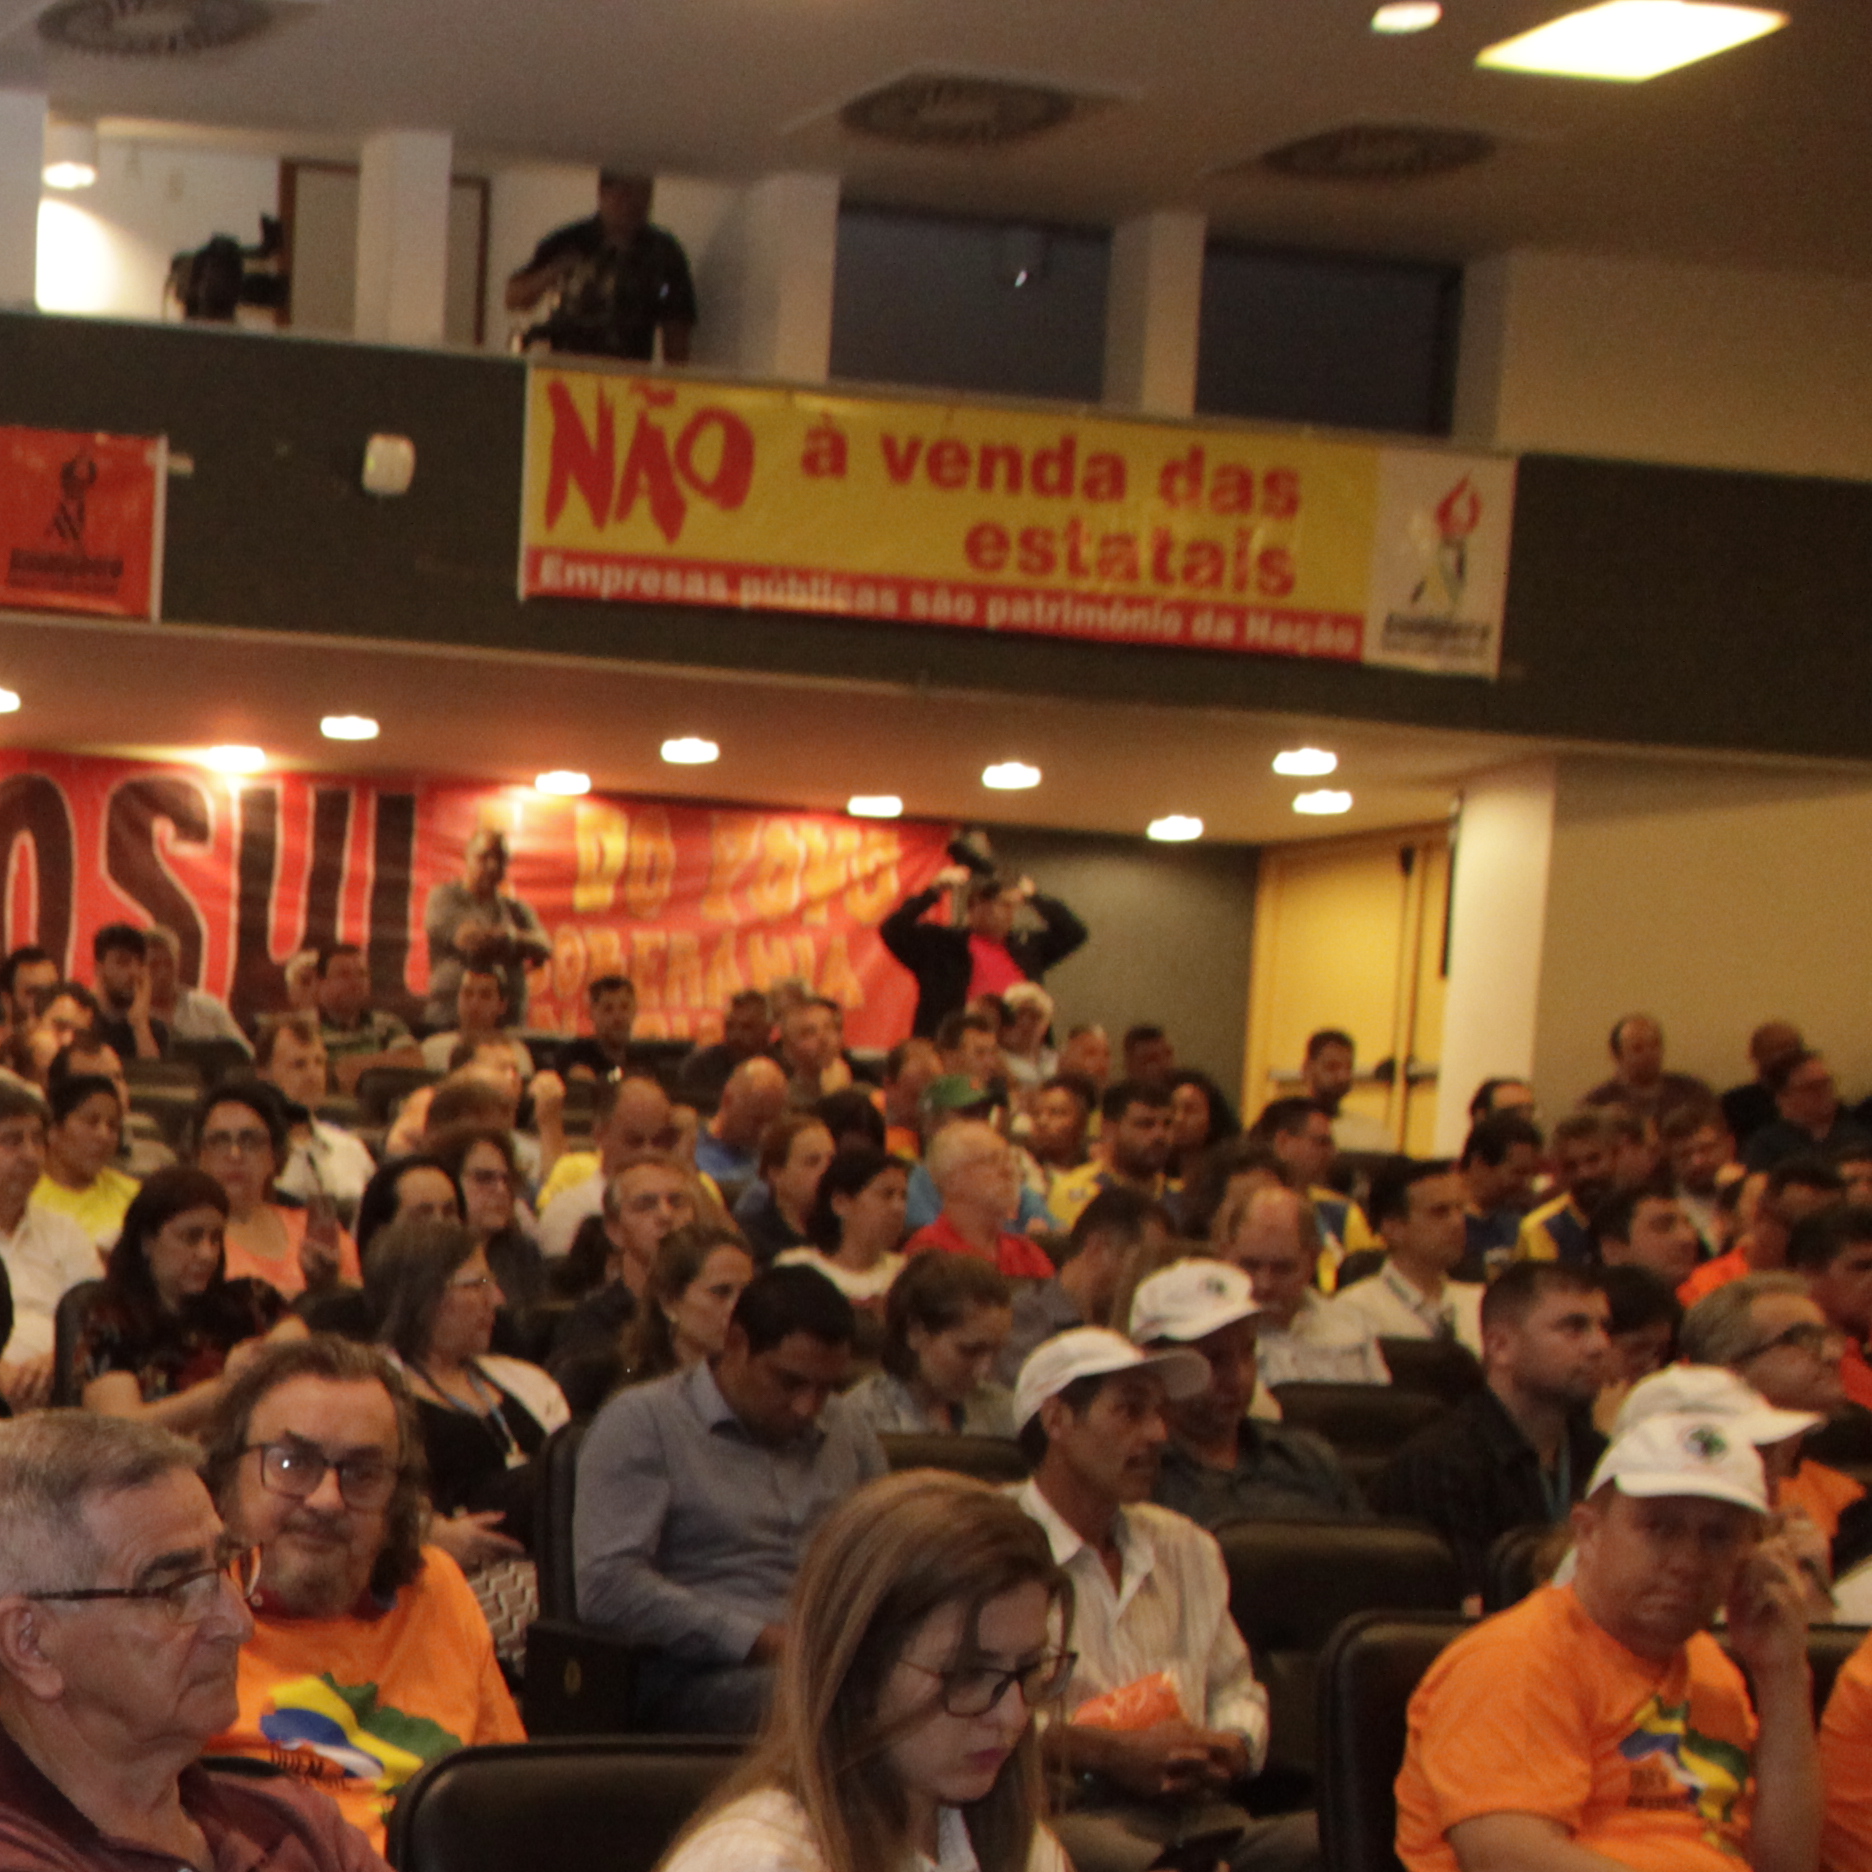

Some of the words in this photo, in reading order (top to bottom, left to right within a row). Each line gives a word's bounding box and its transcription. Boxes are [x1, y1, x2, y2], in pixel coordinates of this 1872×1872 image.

[545, 378, 755, 545] NÃO
[801, 411, 848, 478] à
[881, 434, 1128, 502] venda
[1160, 445, 1299, 519] das
[965, 517, 1295, 597] estatais
